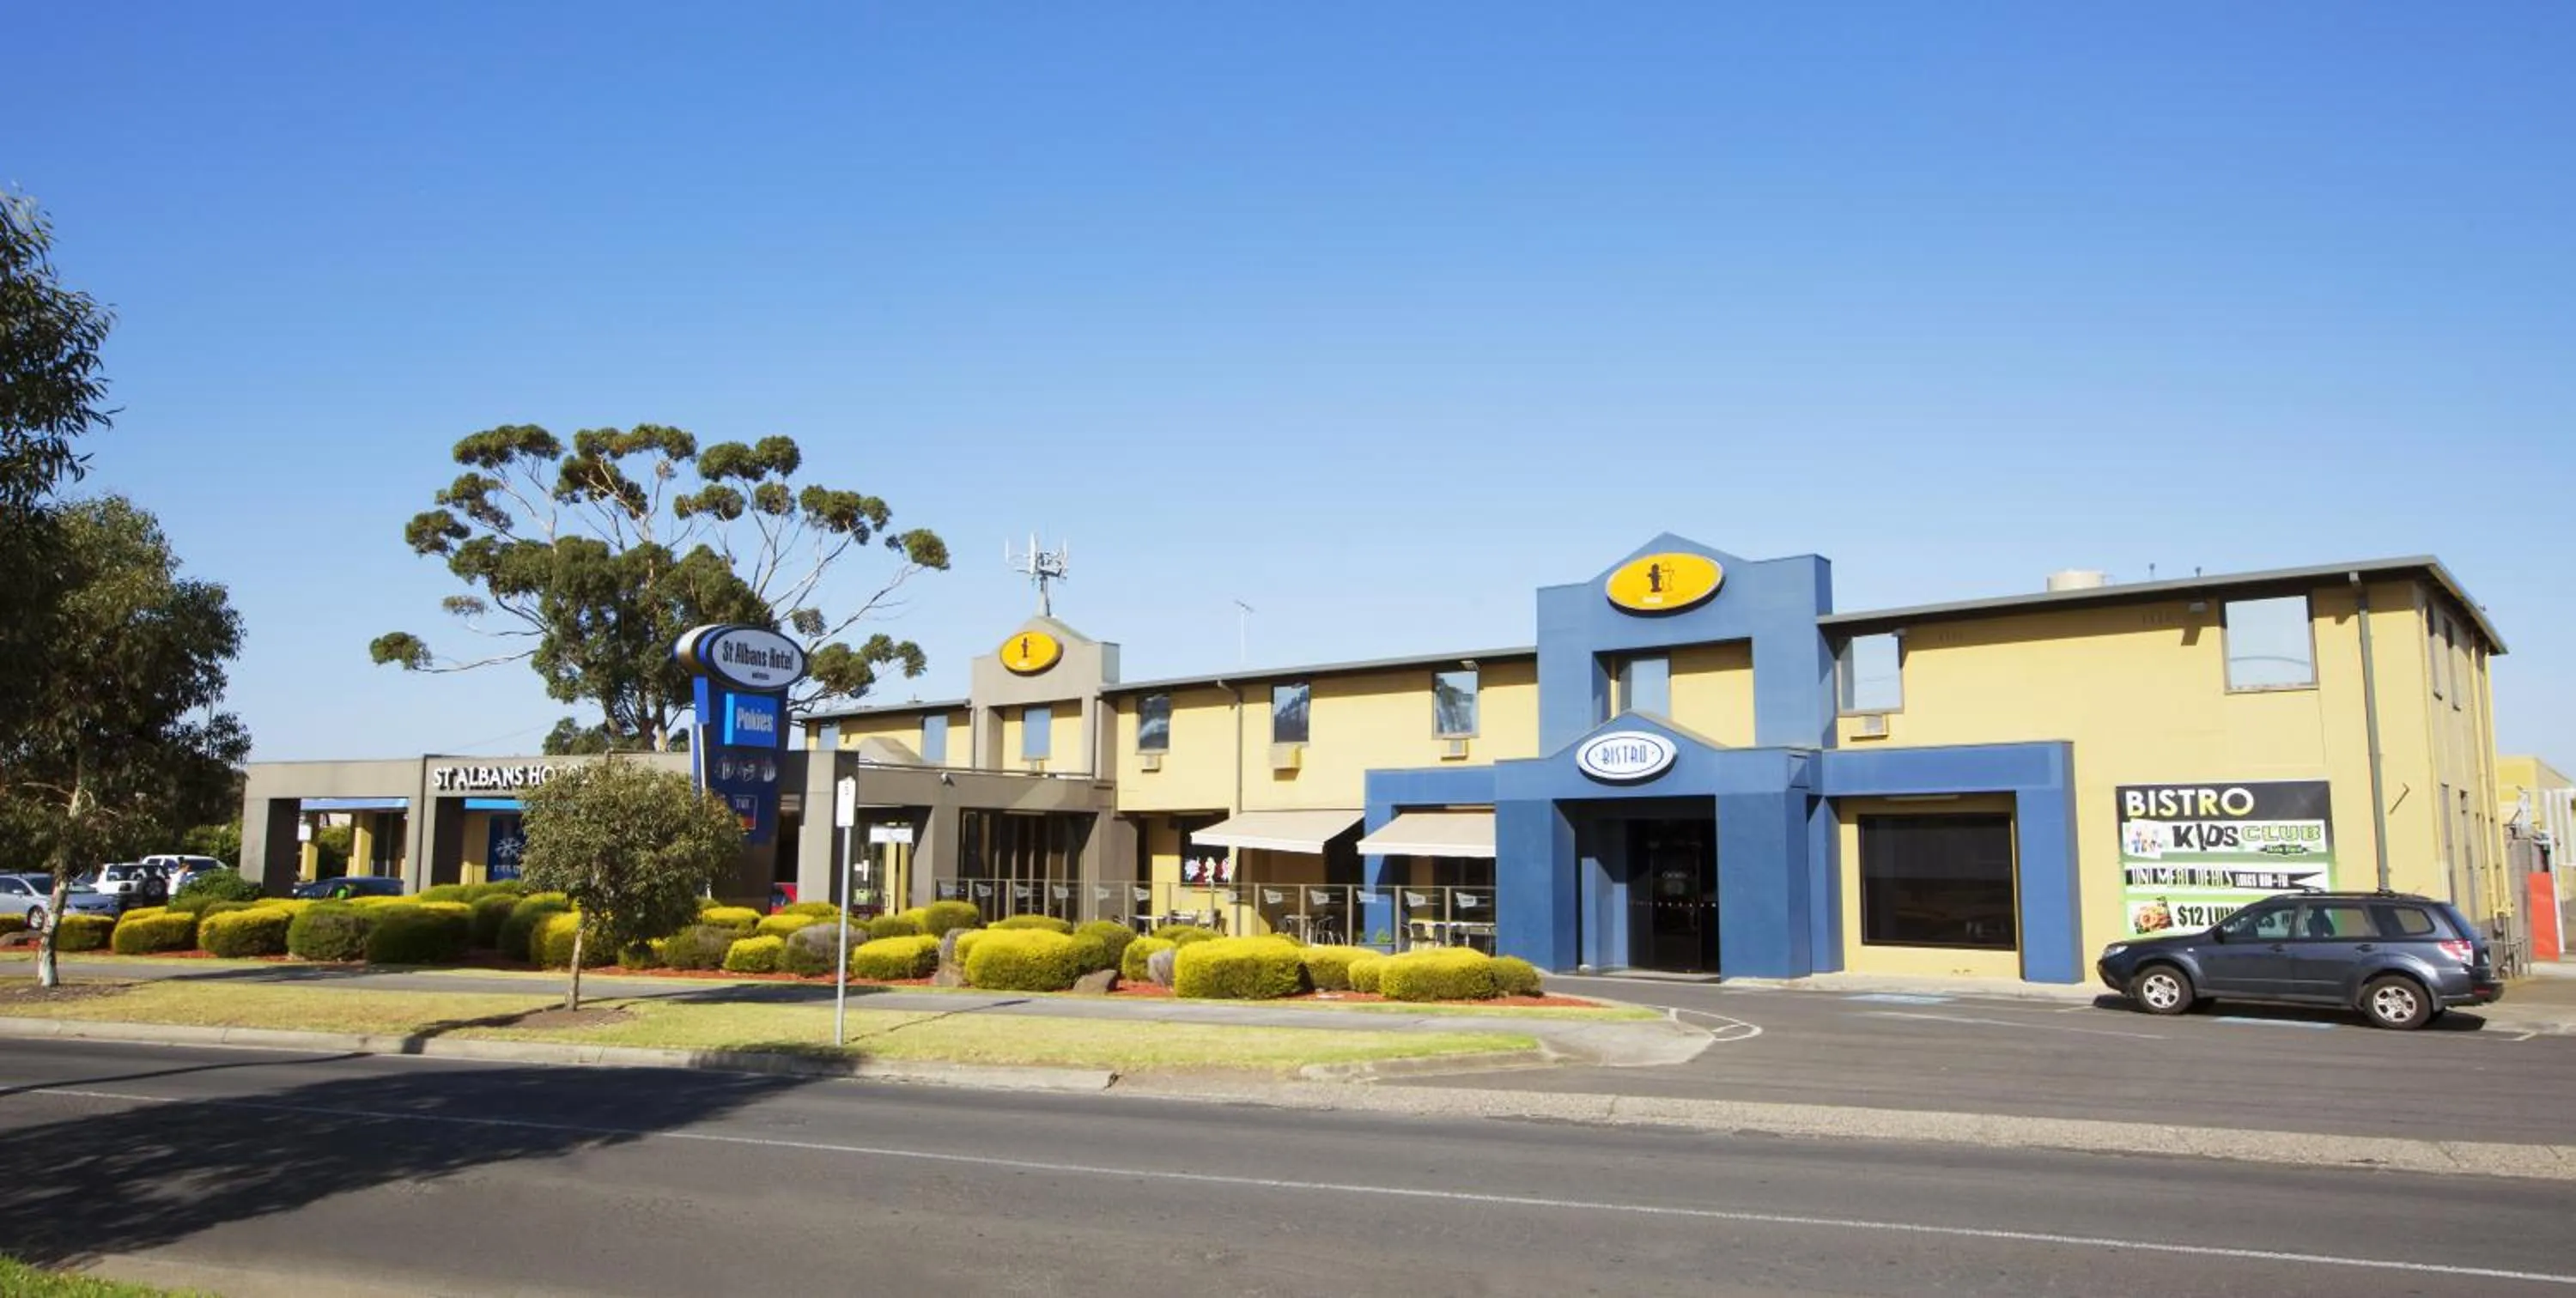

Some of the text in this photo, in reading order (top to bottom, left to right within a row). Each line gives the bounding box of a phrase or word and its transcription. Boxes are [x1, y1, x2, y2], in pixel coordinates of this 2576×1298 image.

[722, 640, 794, 671] St Albans Hotel
[736, 707, 774, 732] Pokies
[1601, 744, 1648, 766] BISTRO
[433, 767, 453, 787] ST
[456, 766, 524, 786] ALBANS
[2125, 787, 2255, 816] BISTRO
[2172, 822, 2322, 851] KIDS CLUB
[2178, 905, 2204, 926] $12
